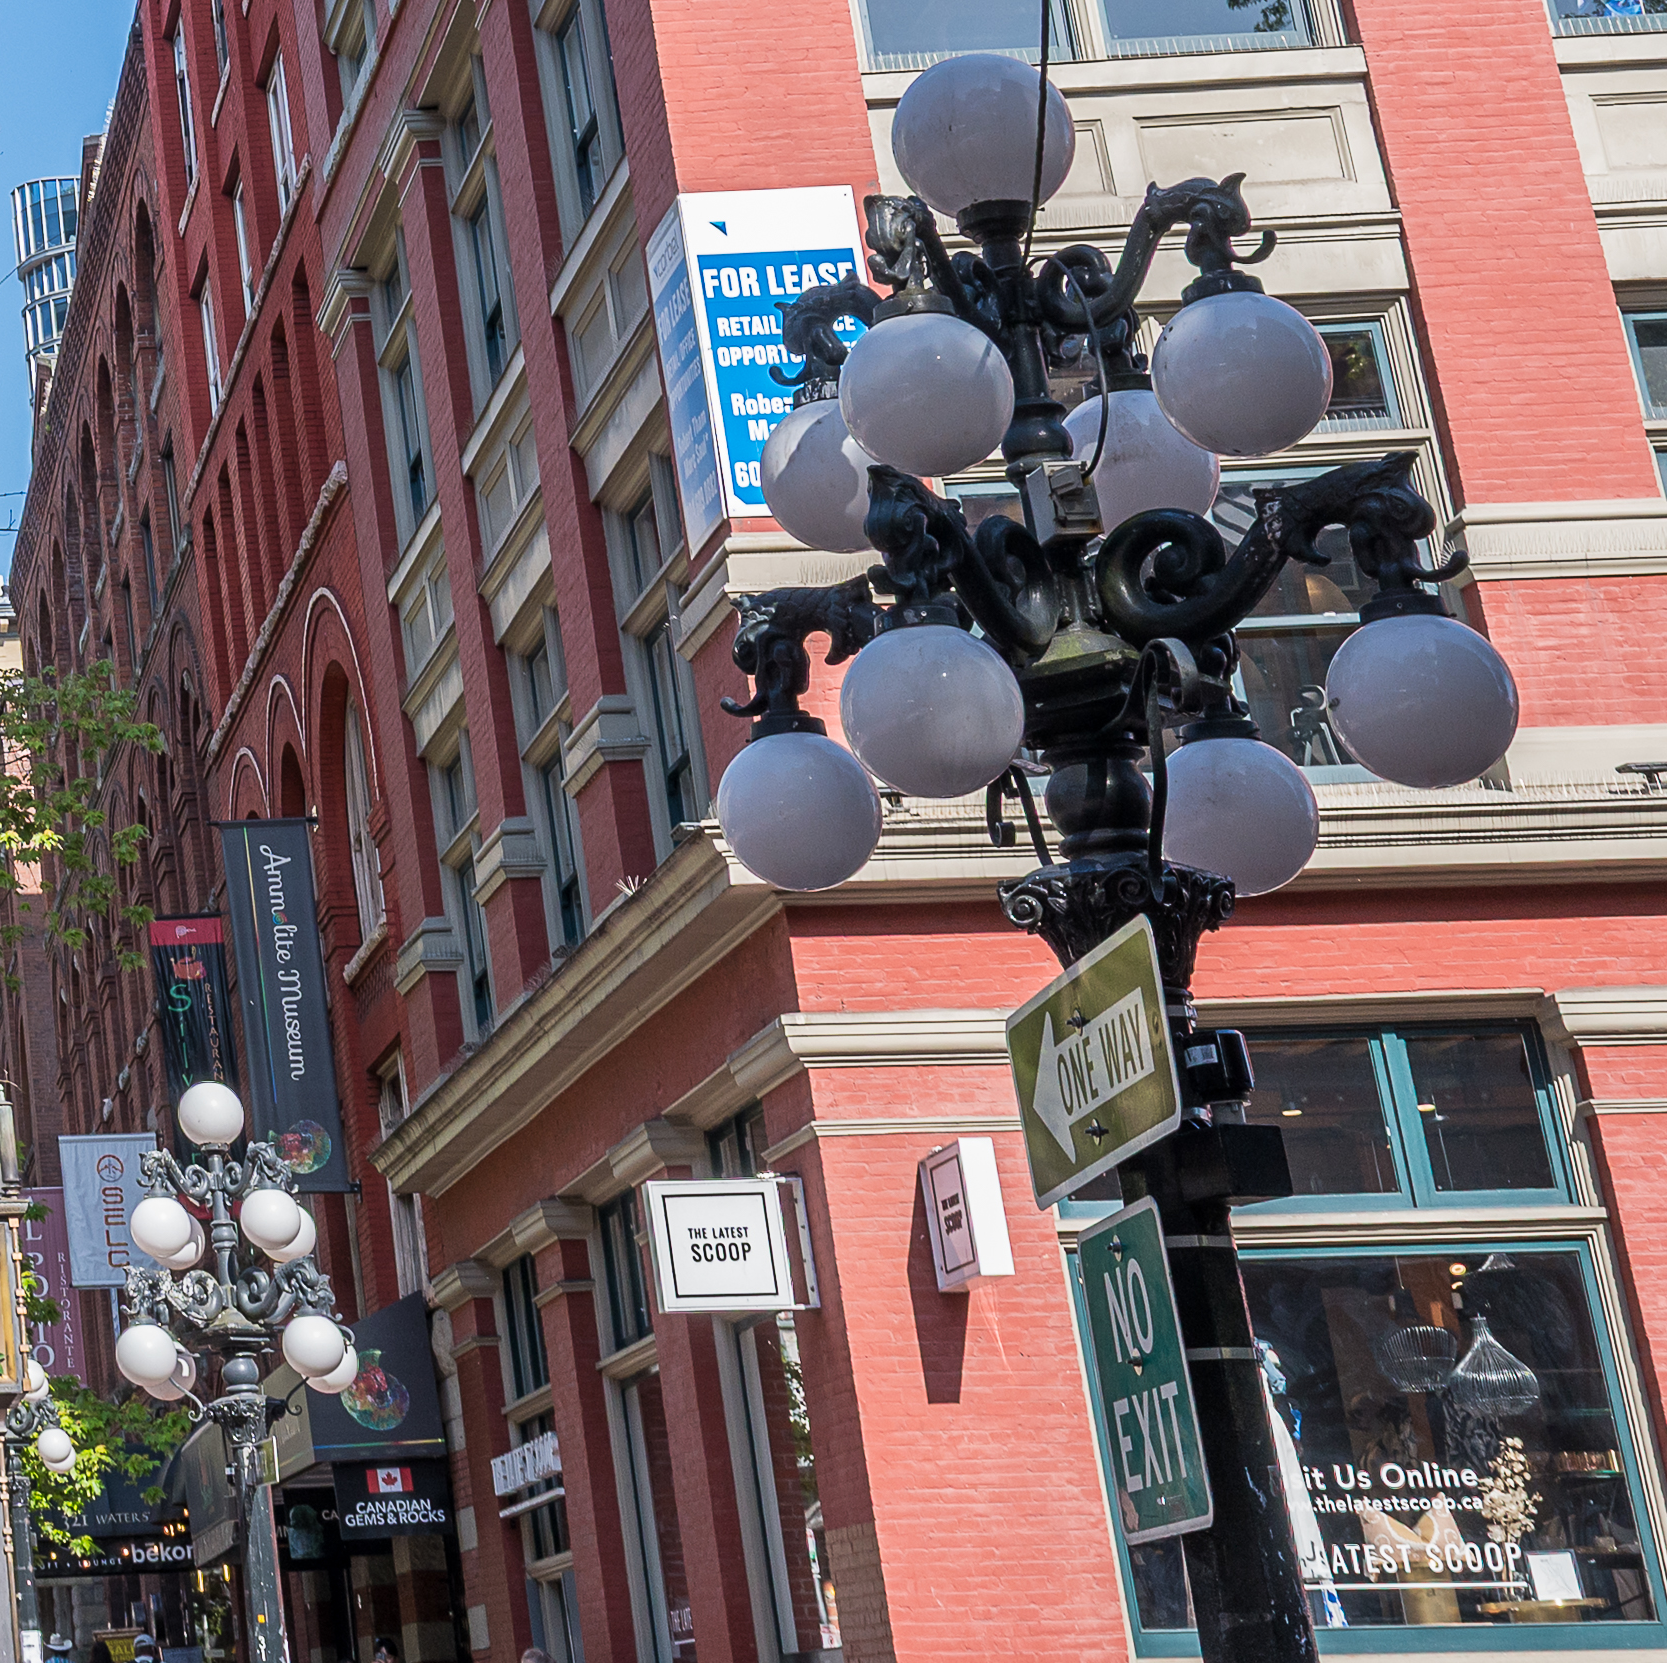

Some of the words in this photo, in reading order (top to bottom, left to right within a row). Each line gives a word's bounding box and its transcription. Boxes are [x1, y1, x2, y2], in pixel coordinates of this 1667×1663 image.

[703, 266, 761, 298] FOR
[656, 303, 672, 347] FOR
[668, 273, 691, 330] LEASE
[718, 315, 781, 336] RETAIL
[731, 393, 793, 416] Rober
[259, 844, 298, 964] Ammolite
[204, 983, 224, 1082] RESTAURAN
[277, 969, 306, 1081] Museum
[1056, 1034, 1098, 1117] ONE
[1098, 1001, 1145, 1093] WAY
[101, 1186, 131, 1268] SELC
[687, 1228, 708, 1240] THE
[712, 1226, 749, 1239] LATEST
[691, 1242, 752, 1263] SCOOP
[57, 1252, 75, 1369] RISTORANTE
[1103, 1257, 1154, 1364] NO
[1113, 1380, 1188, 1494] EXIT
[1332, 1464, 1373, 1490] Us
[1380, 1461, 1479, 1489] Online
[345, 1513, 385, 1527] GEMS
[386, 1512, 398, 1525] &
[399, 1509, 446, 1524] ROCKS
[356, 1498, 432, 1515] CANADIAN
[1332, 1542, 1412, 1575] ATEST
[1425, 1541, 1523, 1574] SCOOP
